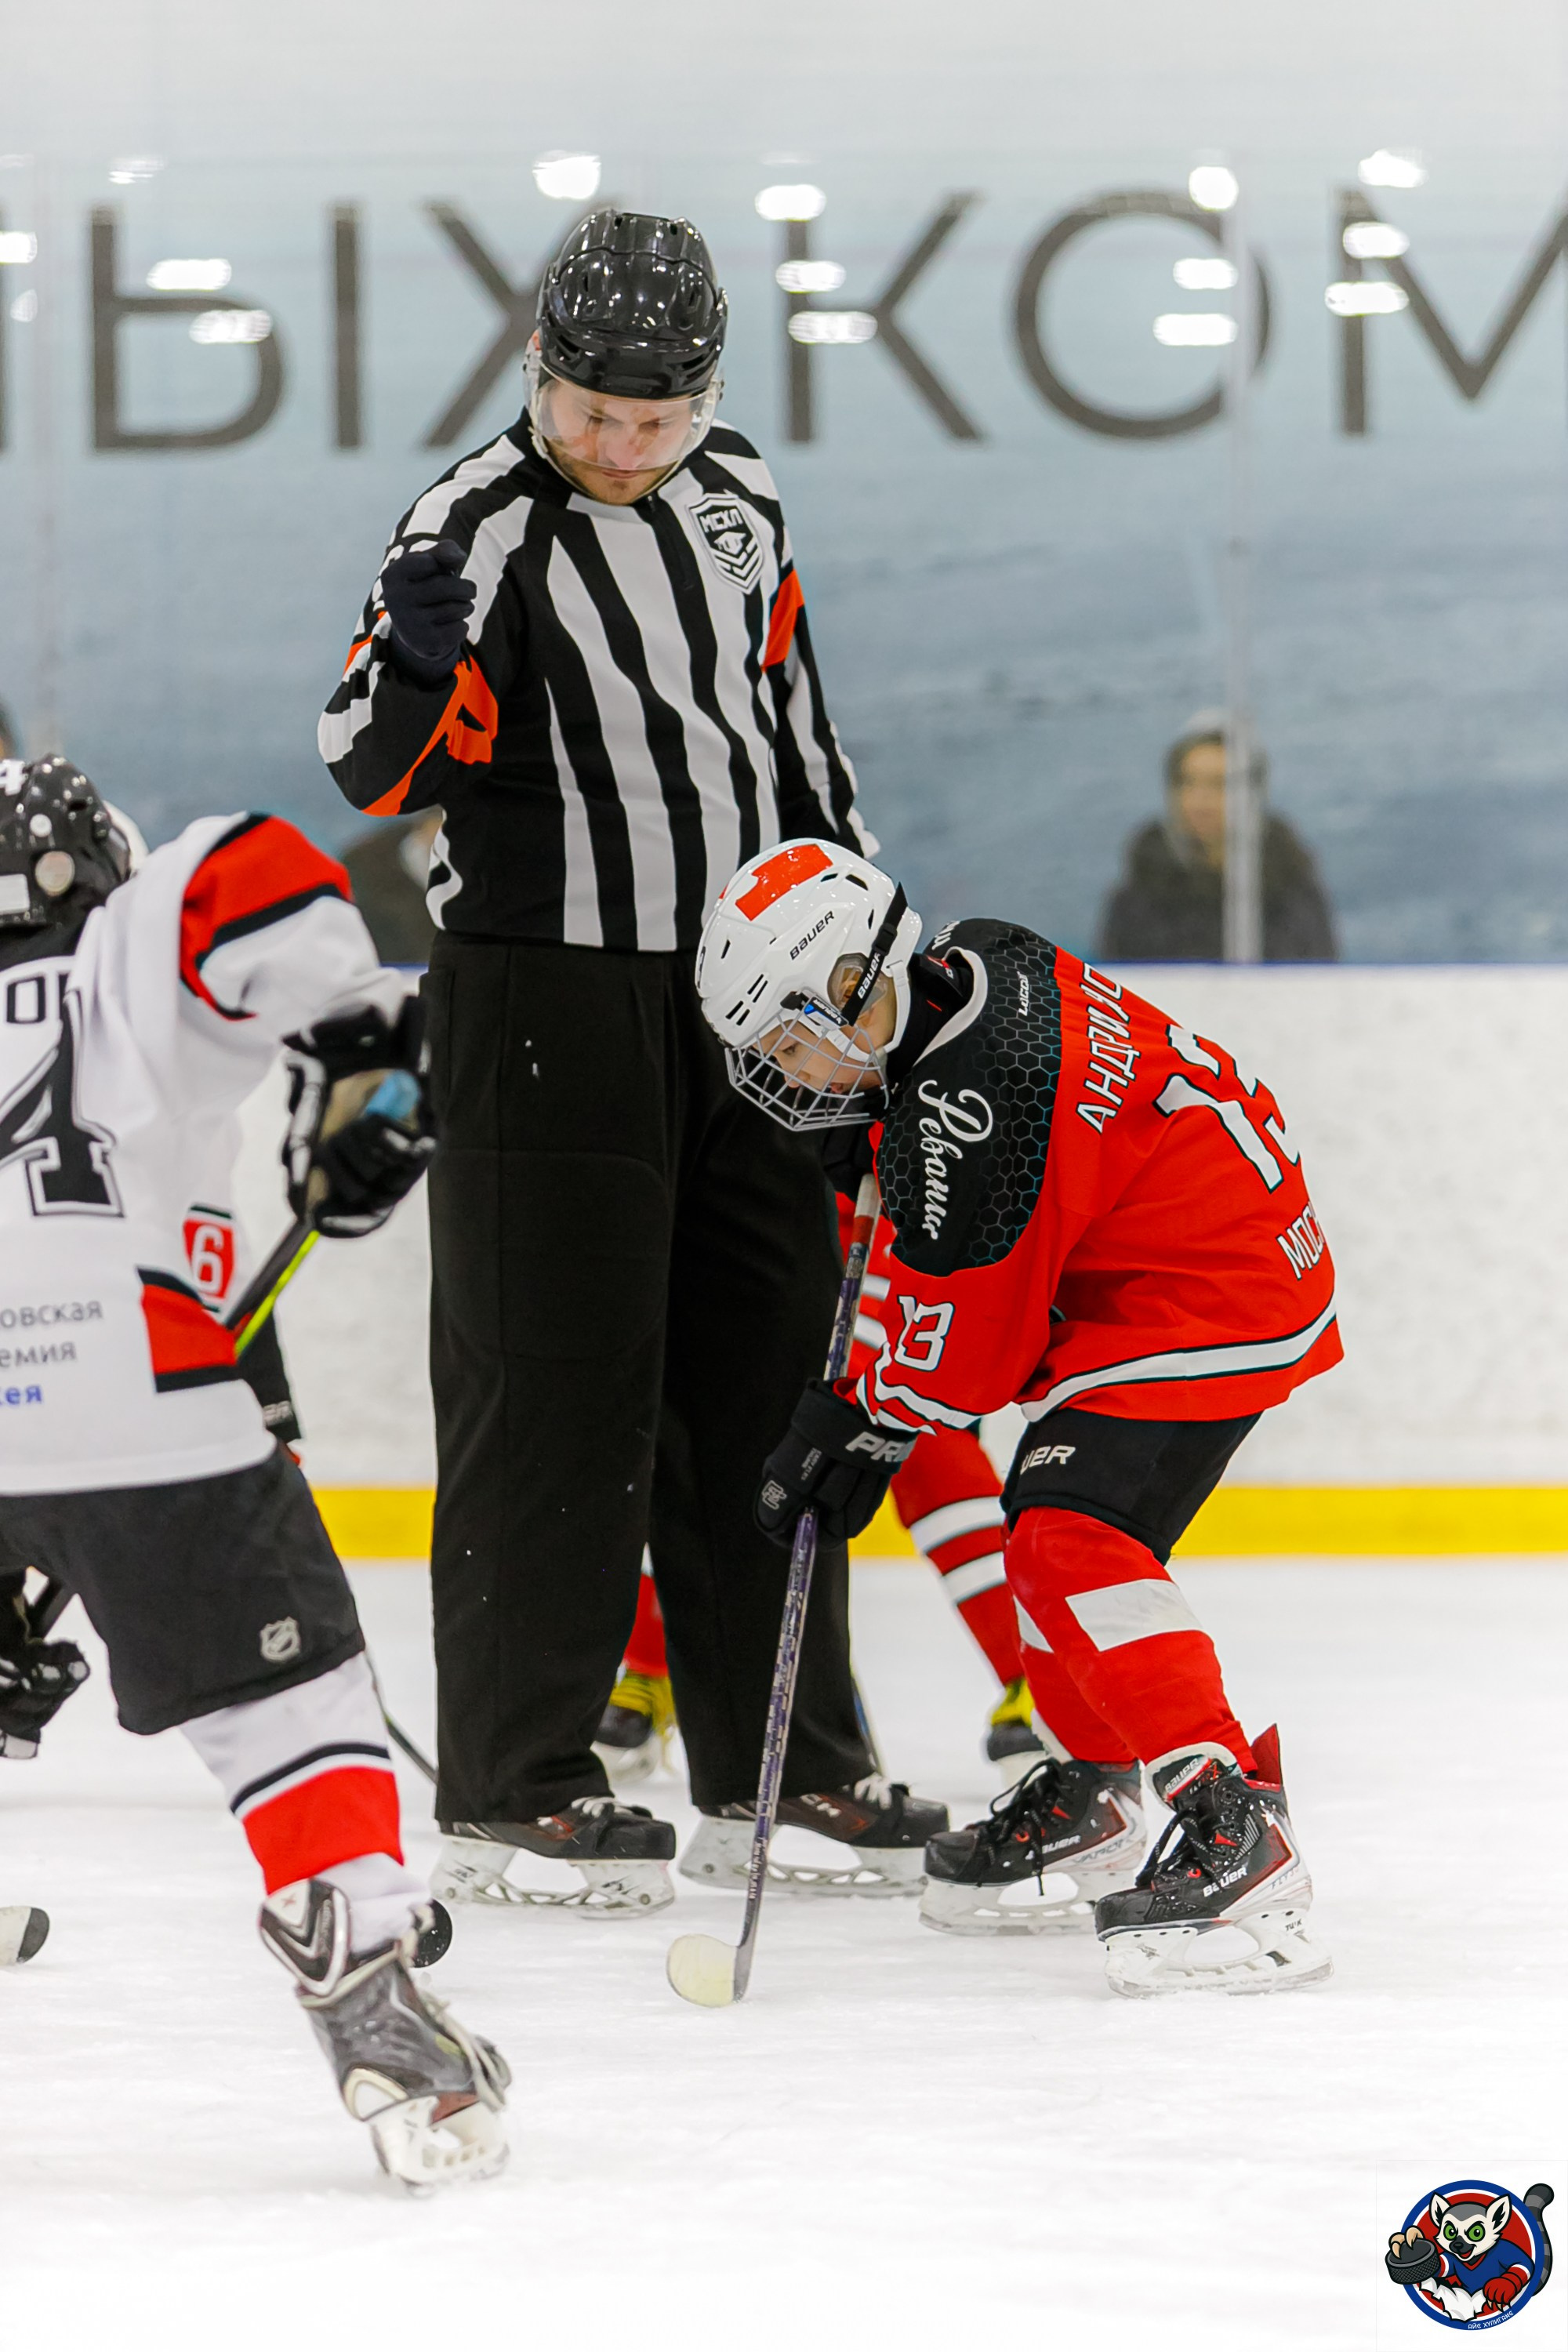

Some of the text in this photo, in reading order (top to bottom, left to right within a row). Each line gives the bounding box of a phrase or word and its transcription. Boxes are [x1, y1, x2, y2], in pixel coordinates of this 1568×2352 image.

[0, 198, 621, 450] ЫХ
[894, 1292, 956, 1372] 13
[0, 1385, 42, 1405] ея
